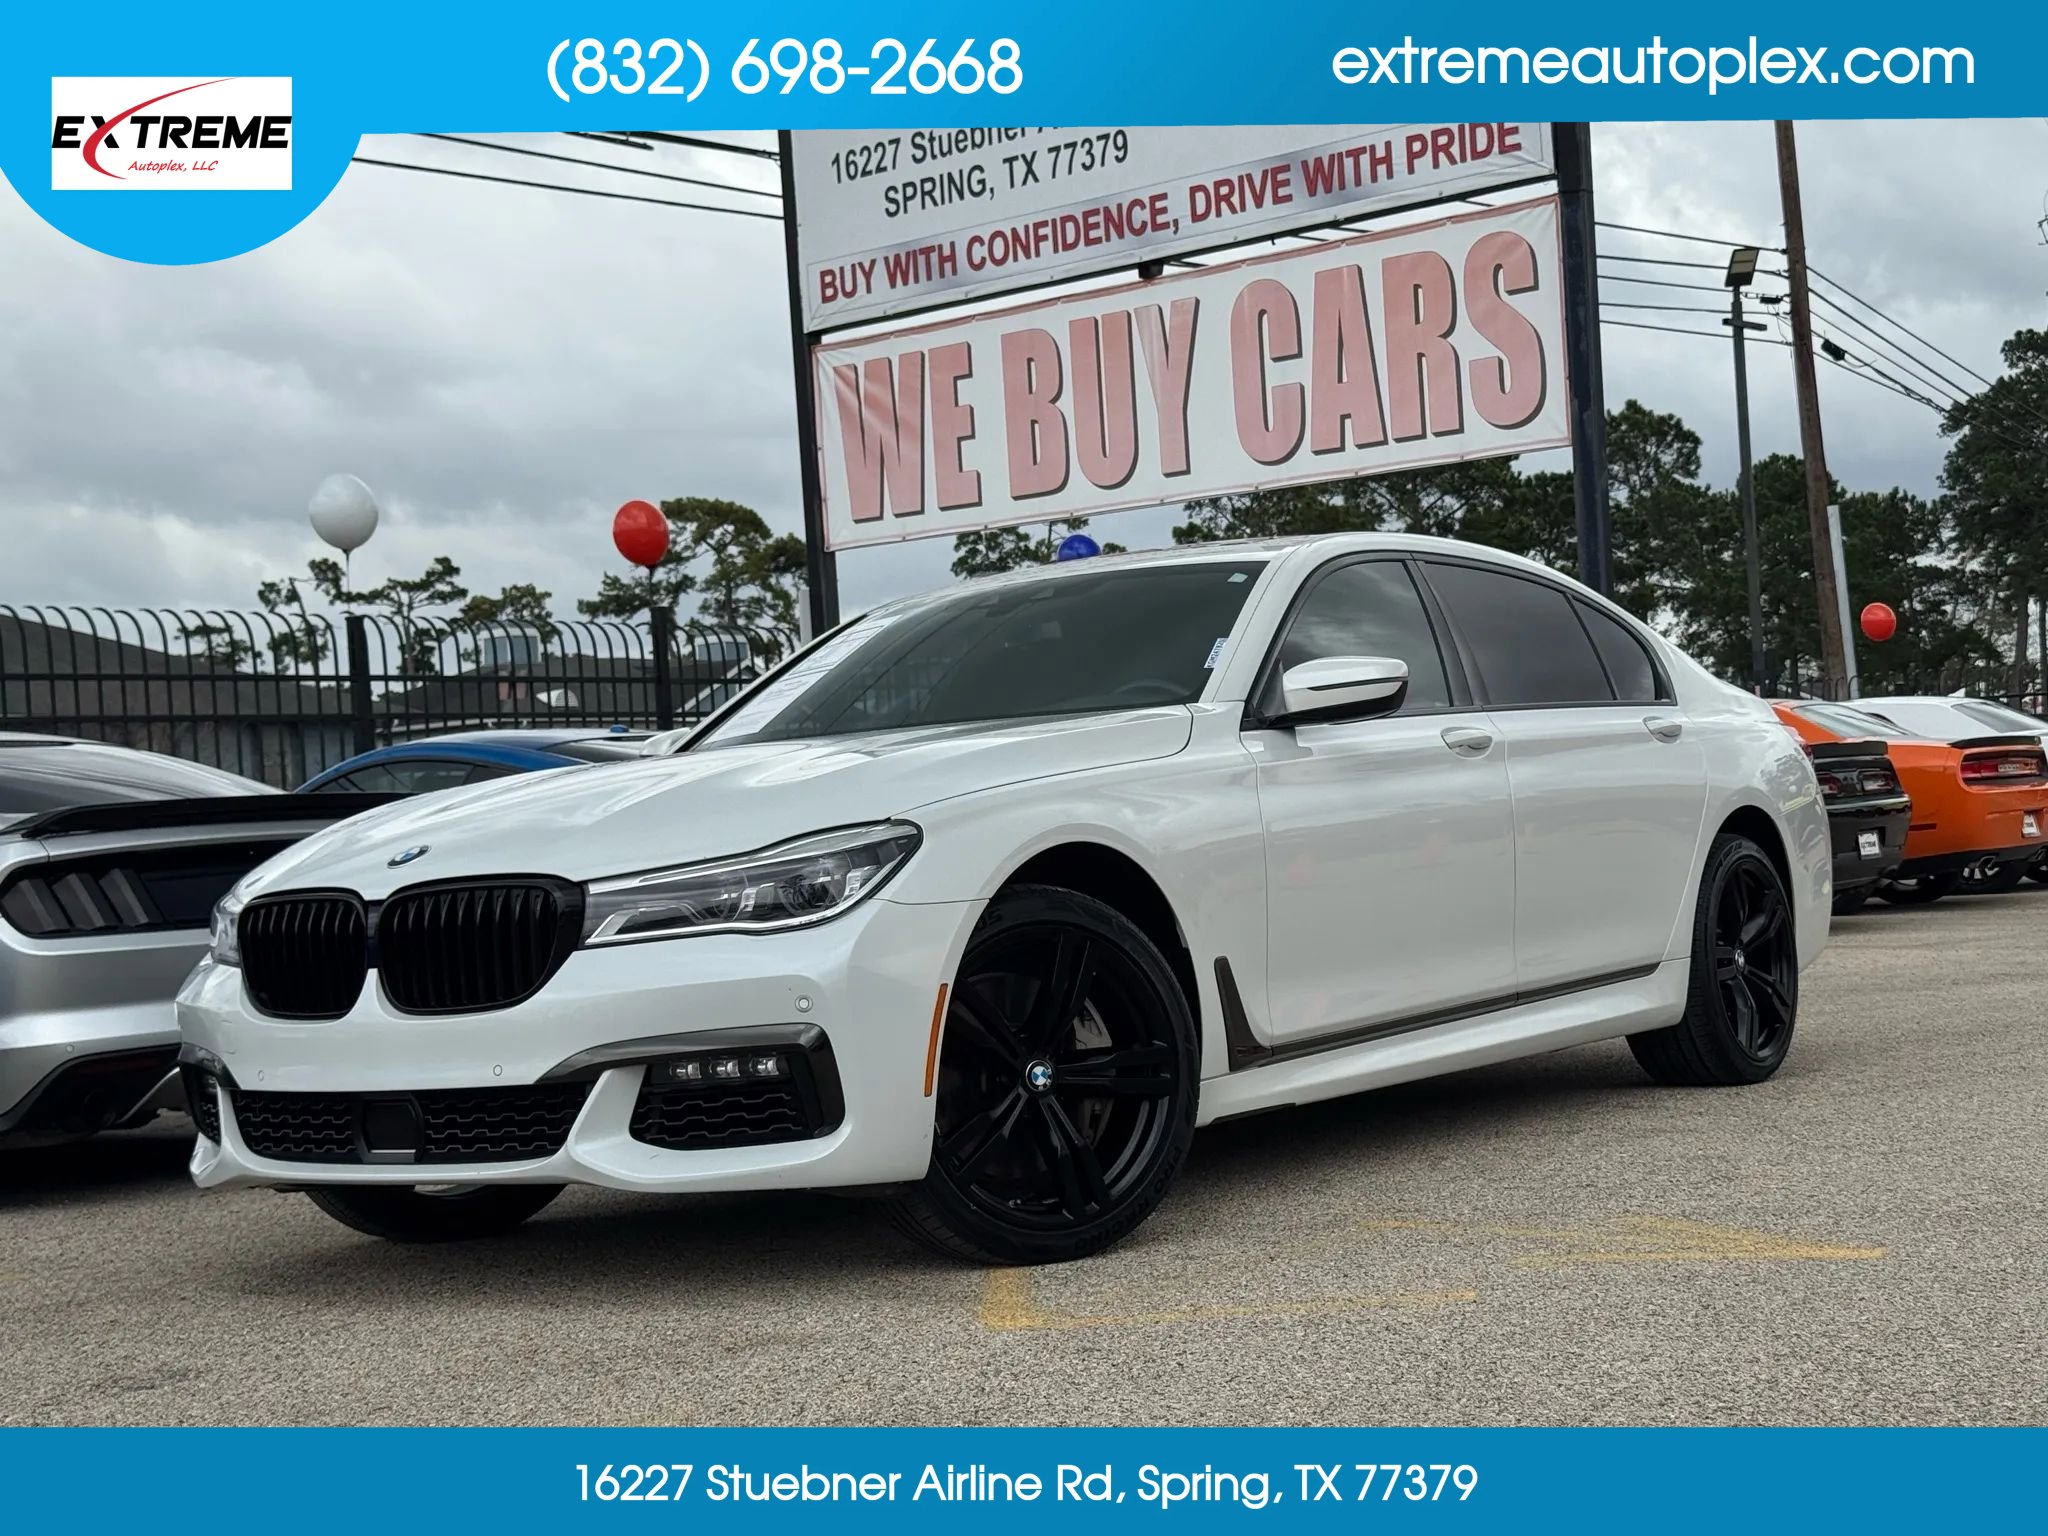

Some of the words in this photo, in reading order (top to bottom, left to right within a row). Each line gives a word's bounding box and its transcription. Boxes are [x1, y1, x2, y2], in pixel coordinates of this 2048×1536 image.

[820, 258, 876, 304] BUY
[883, 241, 958, 290] WITH
[966, 193, 1180, 271] CONFIDENCE,
[1189, 164, 1293, 223] DRIVE
[1301, 140, 1394, 197] WITH
[1405, 122, 1522, 175] PRIDE
[831, 137, 901, 184] 16227
[884, 164, 995, 218] SPRING,
[1003, 150, 1040, 189] TX
[1047, 129, 1128, 179] 77379
[832, 341, 983, 523] WE
[1000, 296, 1200, 500] BUY
[1230, 230, 1546, 466] CARS
